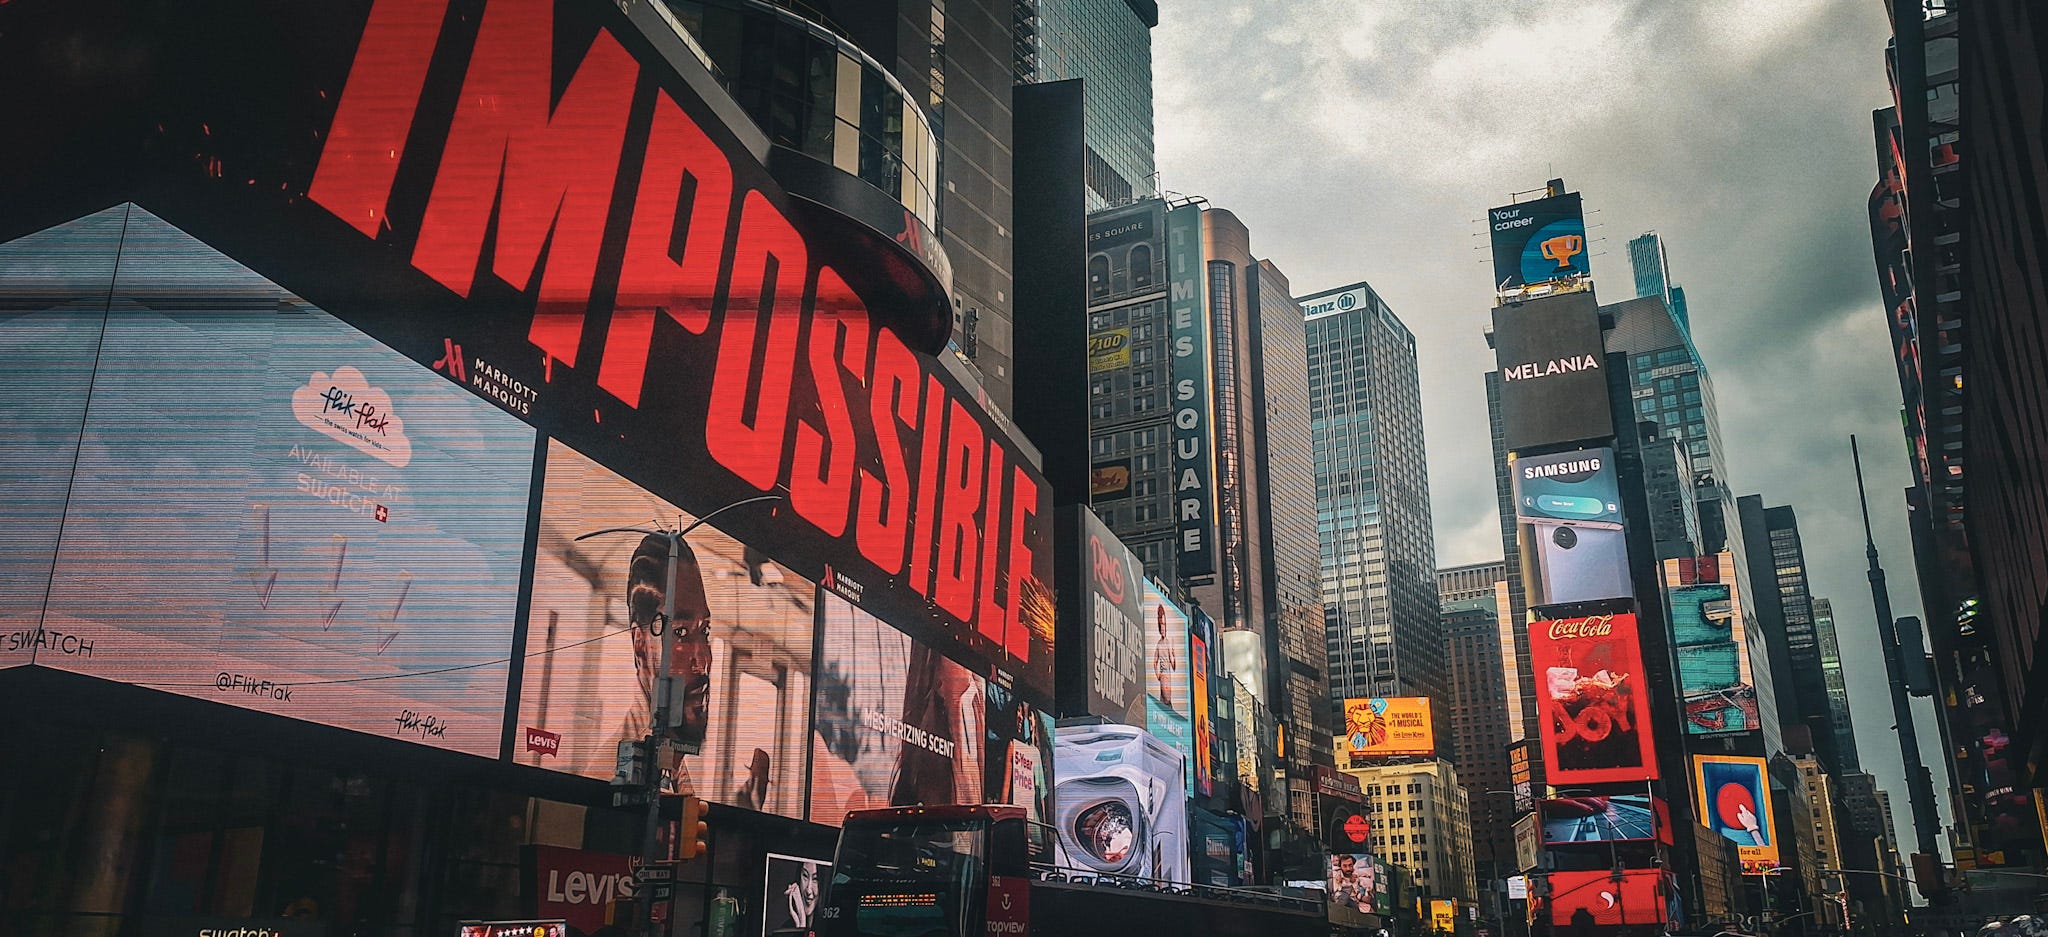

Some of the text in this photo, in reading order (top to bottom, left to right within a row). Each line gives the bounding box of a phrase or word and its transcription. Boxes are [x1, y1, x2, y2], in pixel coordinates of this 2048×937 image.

[1493, 207, 1520, 221] Your
[1494, 216, 1534, 232] career
[1105, 222, 1144, 238] SQUARE
[1303, 301, 1335, 316] ianz
[307, 0, 1038, 664] IMPOSSIBLE
[475, 358, 538, 402] MARRIOTT
[1504, 354, 1600, 382] MELANIA
[473, 374, 529, 415] MARQUIS
[1171, 225, 1202, 553] TIMES SQUARE
[320, 386, 389, 437] flik flak
[288, 443, 402, 502] AVAILABLE AT
[1525, 458, 1601, 479] SAMSUNG
[296, 473, 374, 515] swatch
[837, 572, 864, 594] MARRIOTT
[837, 583, 860, 602] MARQUIS
[1094, 591, 1124, 643] BOXING
[1123, 614, 1142, 659] TAKES
[1548, 615, 1613, 640] Coca-Cola
[8, 629, 95, 658] SWATCH
[1094, 624, 1116, 672] OVER
[1116, 639, 1137, 685] TIMES
[216, 671, 293, 703] @FlikFlak
[1094, 657, 1125, 709] SQUARE
[395, 709, 447, 739] flik flak
[864, 707, 955, 758] MESMERIZING SCENT
[1397, 718, 1425, 727] MUSICAL
[1014, 768, 1032, 790] Price
